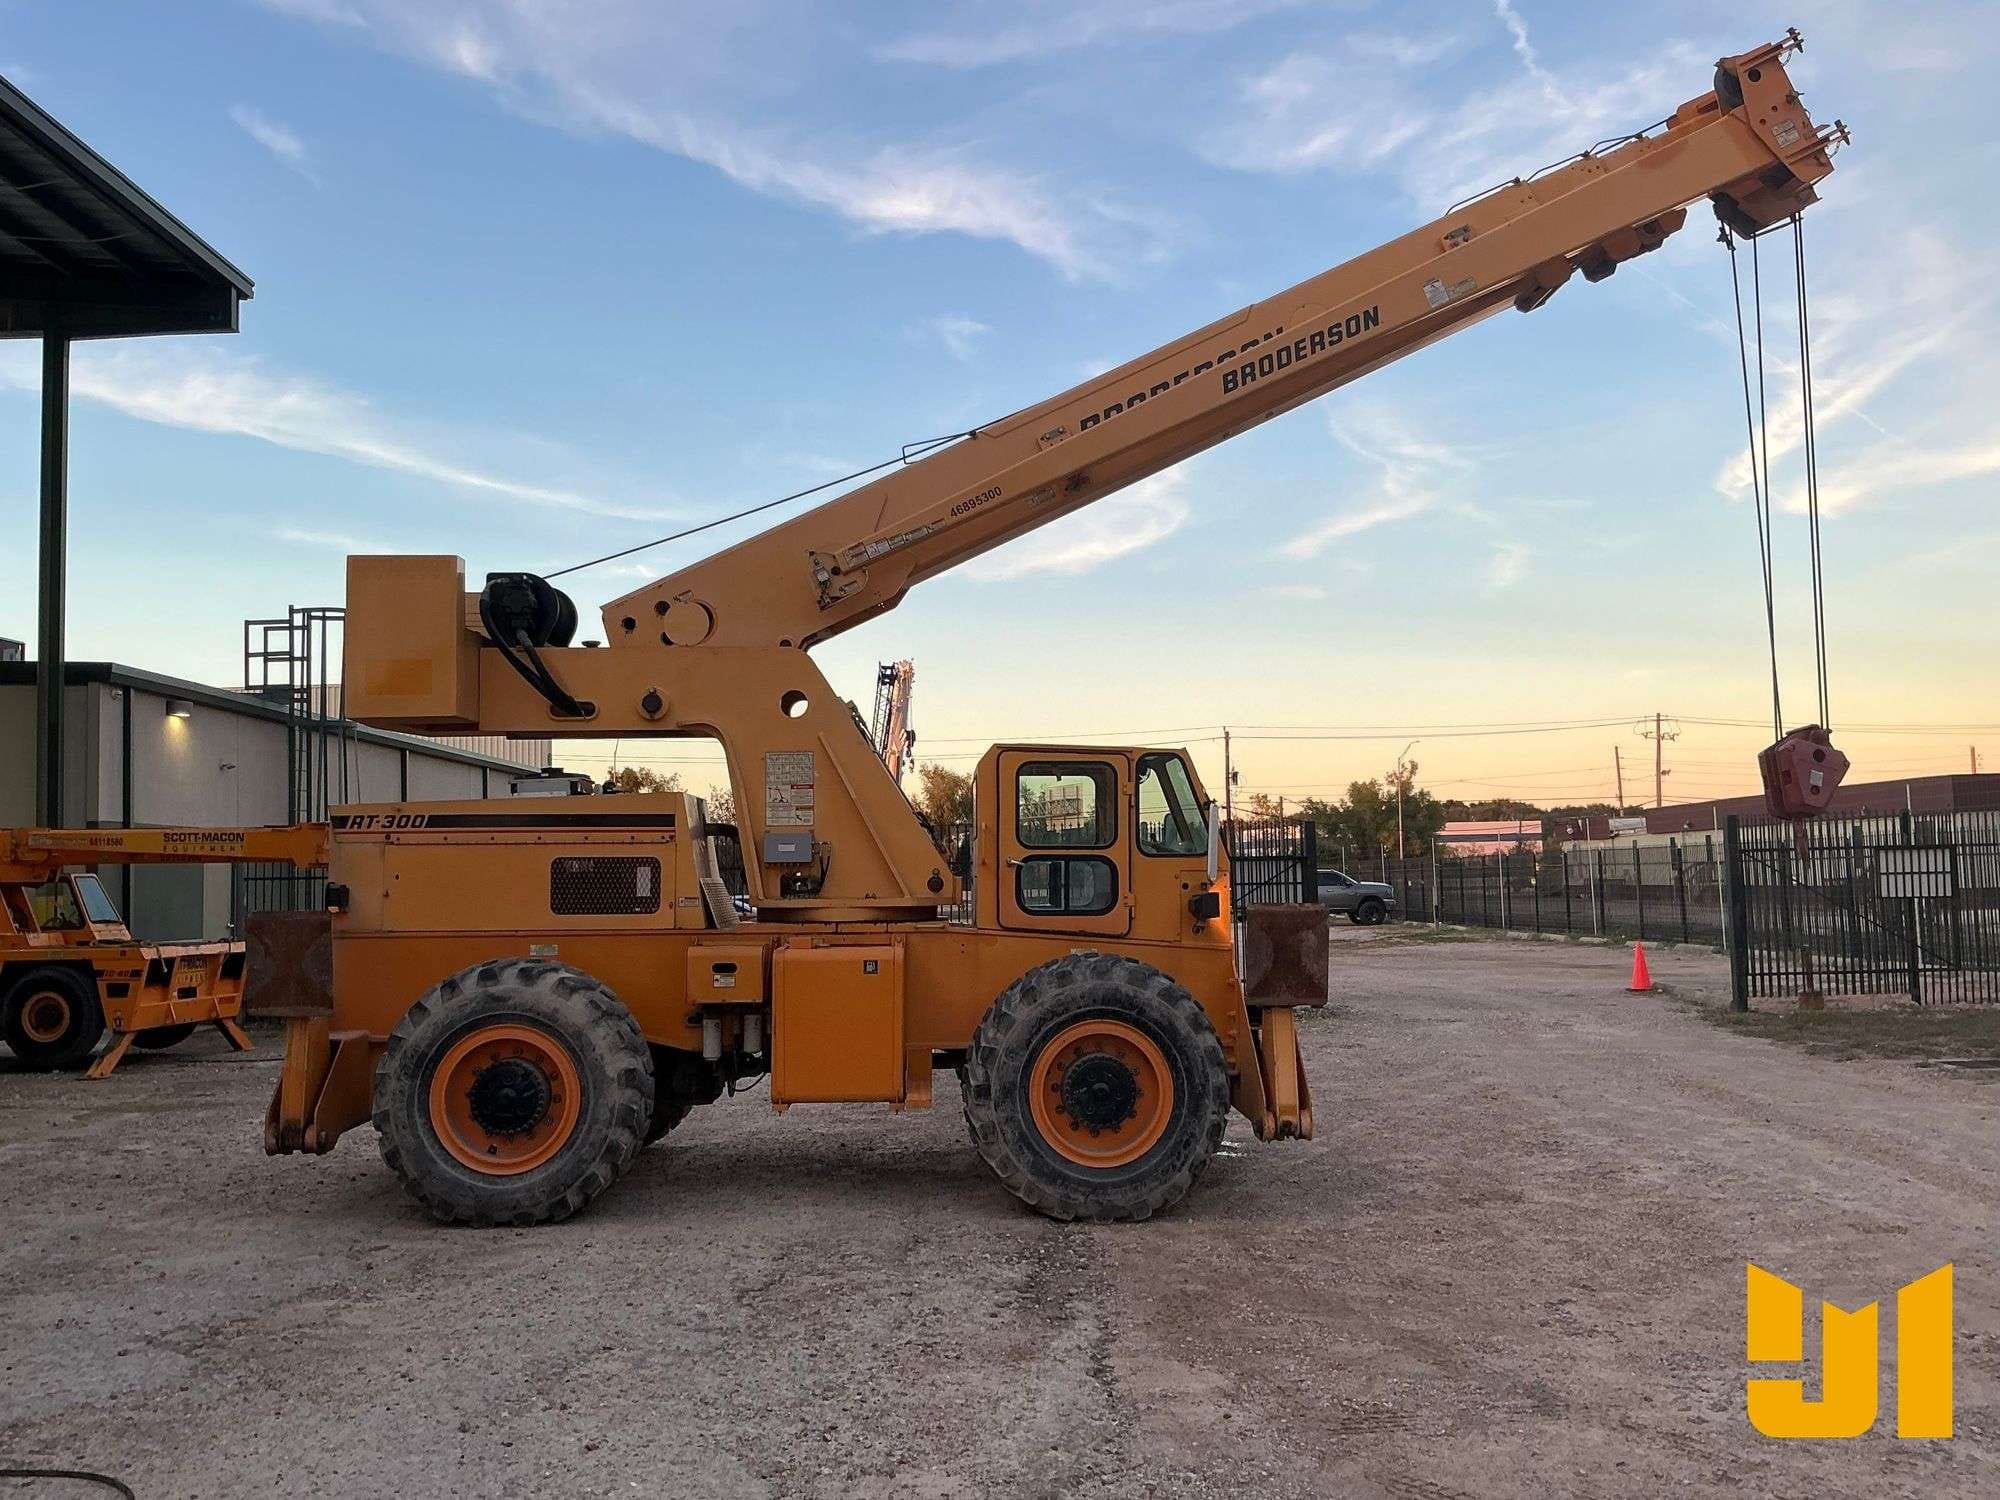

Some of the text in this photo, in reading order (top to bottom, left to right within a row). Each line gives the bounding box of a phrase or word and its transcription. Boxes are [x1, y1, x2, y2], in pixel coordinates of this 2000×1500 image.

[1221, 305, 1380, 395] BRODERSON
[950, 486, 1003, 518] 46895300
[348, 813, 426, 829] RT-300
[163, 832, 245, 843] SCOTT-MACON
